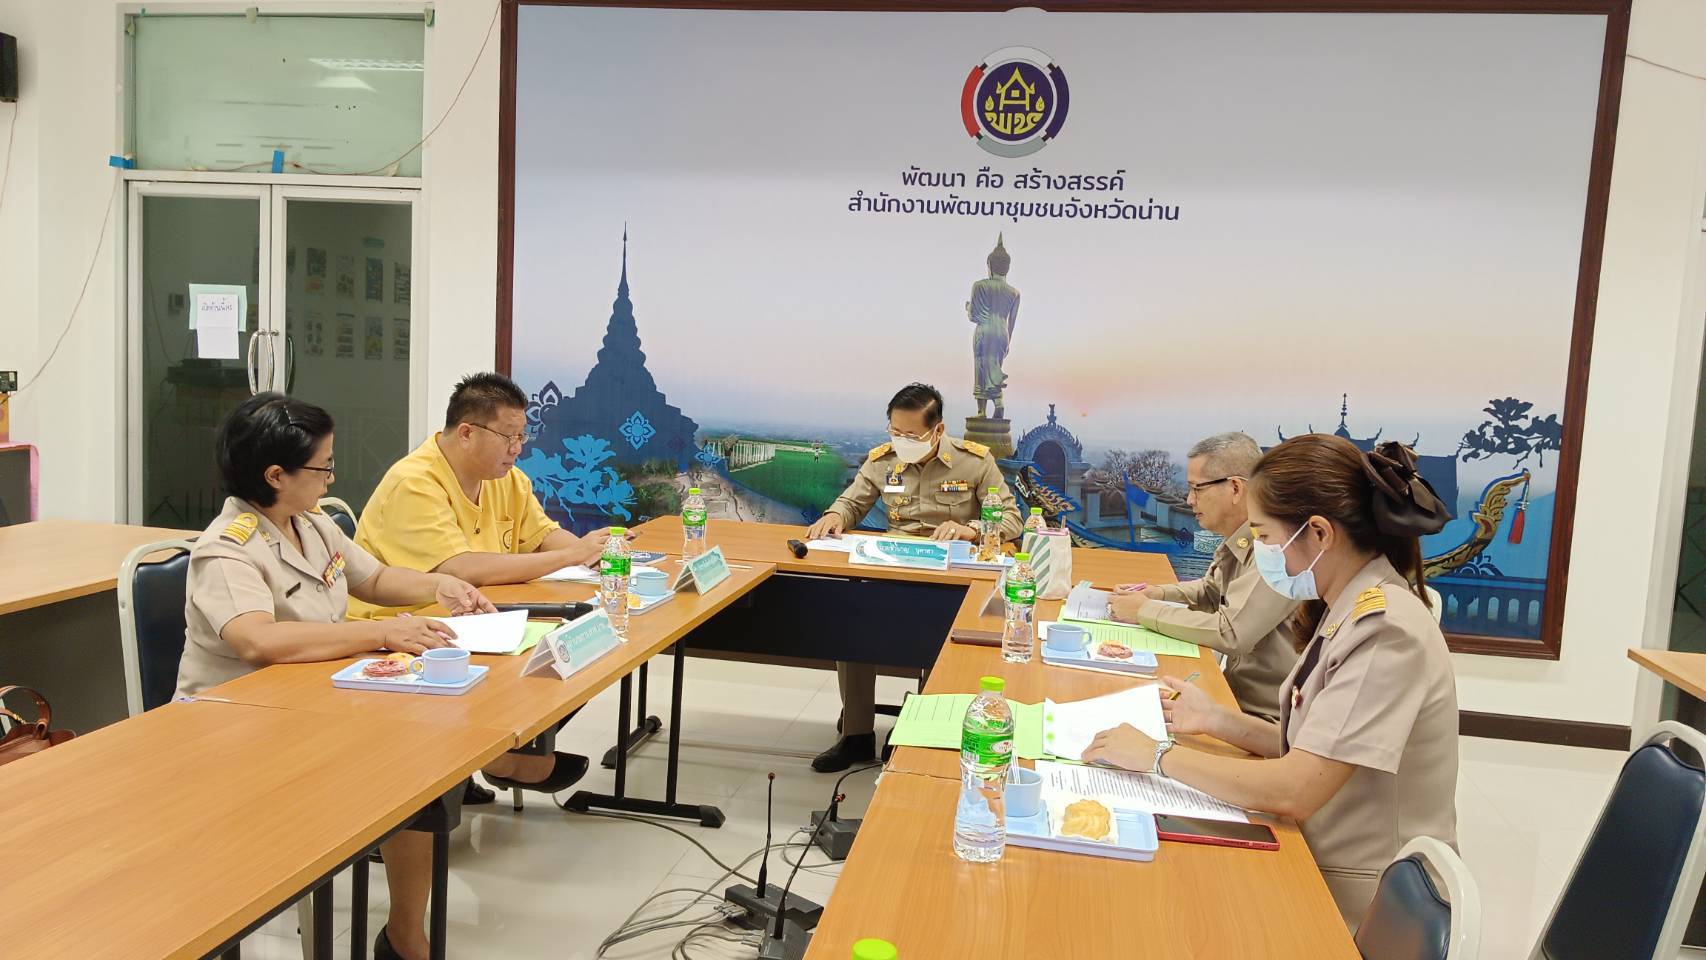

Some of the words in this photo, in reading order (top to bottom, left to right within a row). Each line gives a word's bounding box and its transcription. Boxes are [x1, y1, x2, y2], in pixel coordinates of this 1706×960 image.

[902, 165, 966, 188] พัฒนา
[975, 166, 1004, 189] คือ
[1013, 167, 1126, 191] สร้างสรรค์
[848, 189, 1180, 223] สำนักงานพัฒนาชุมชนจังหวัดน่าน
